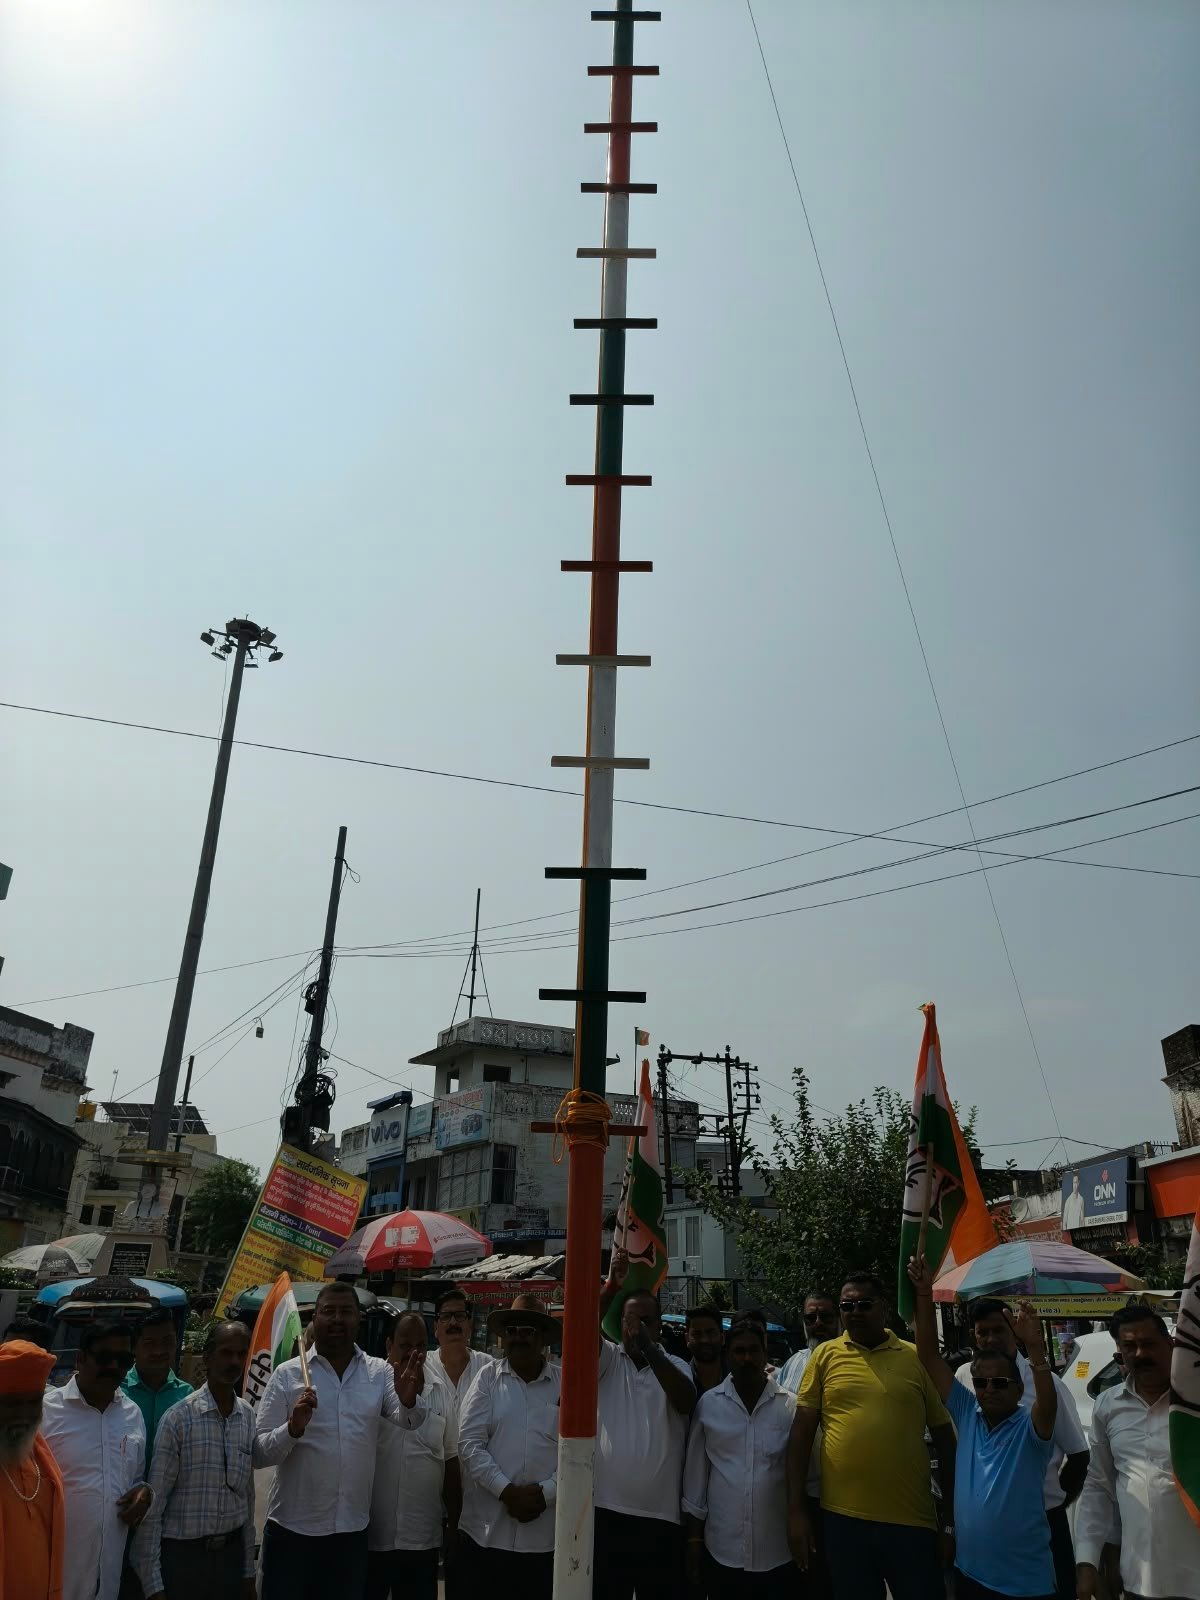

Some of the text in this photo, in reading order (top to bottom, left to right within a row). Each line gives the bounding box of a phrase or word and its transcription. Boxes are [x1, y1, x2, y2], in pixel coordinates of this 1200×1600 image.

[371, 1120, 401, 1144] vivo
[296, 1159, 331, 1181] सार्वजनिक
[330, 1175, 350, 1191] सूचना
[1094, 1182, 1116, 1201] ONN
[305, 1225, 321, 1238] Point
